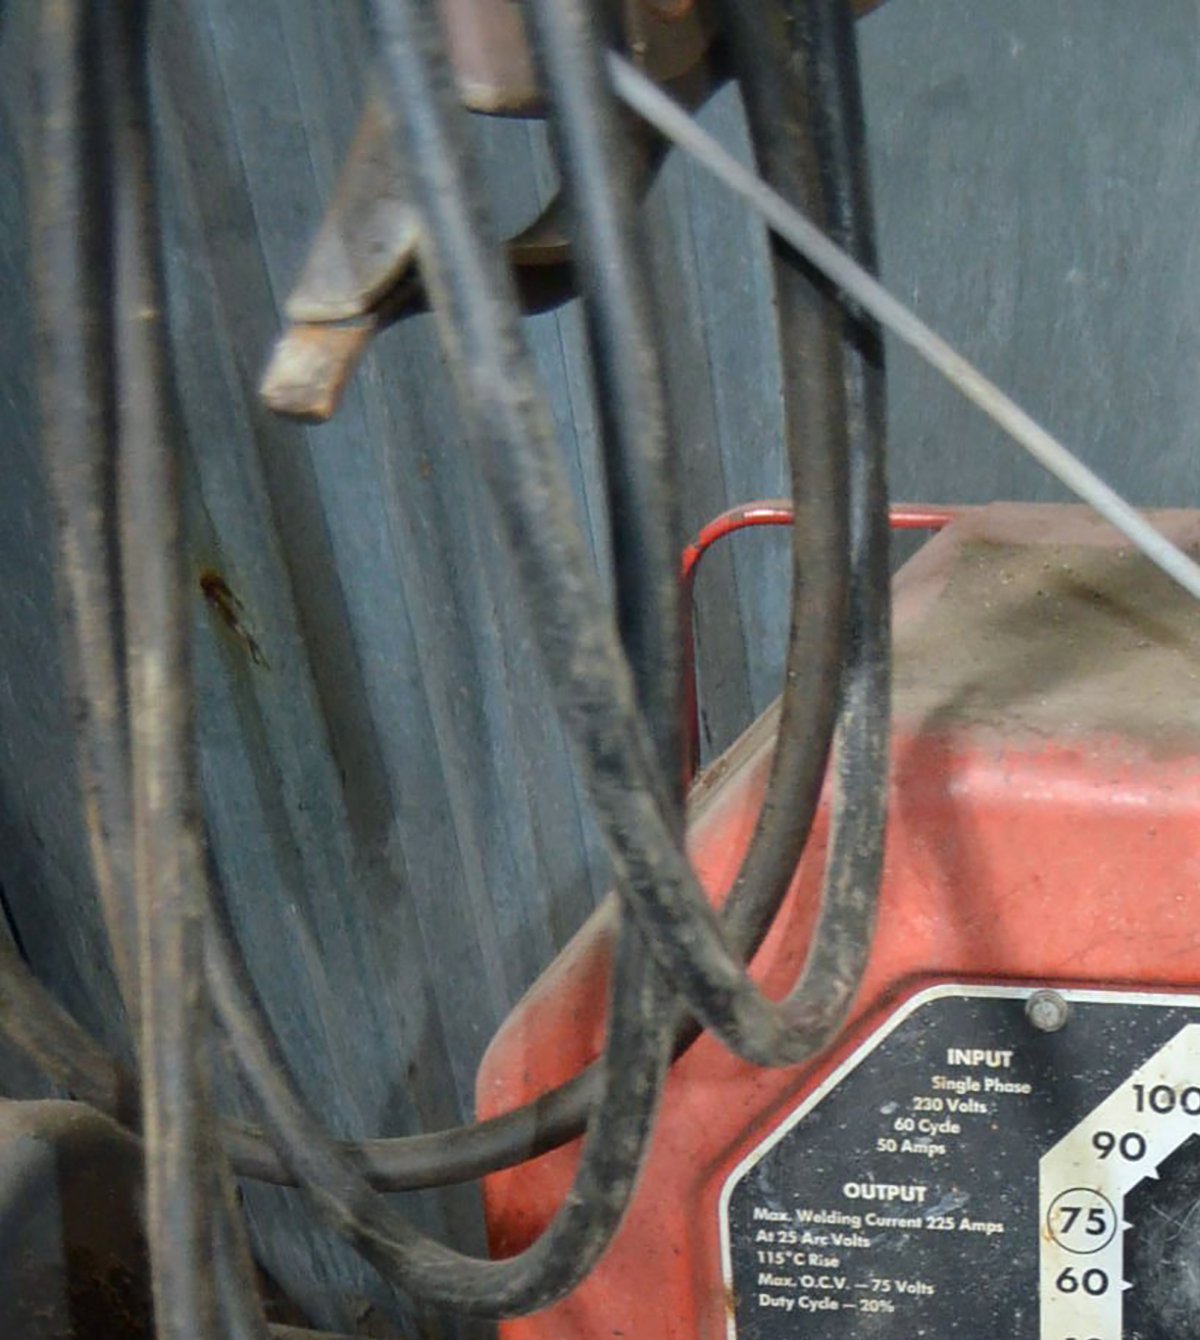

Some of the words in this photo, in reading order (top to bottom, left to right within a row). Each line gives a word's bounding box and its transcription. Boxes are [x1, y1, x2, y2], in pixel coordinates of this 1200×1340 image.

[947, 1048, 1014, 1068] INPUT
[932, 1076, 980, 1094] Single
[984, 1079, 1032, 1094] Phase
[913, 1098, 943, 1112] 230
[946, 1099, 988, 1114] Volts
[894, 1118, 914, 1131] 60
[919, 1120, 961, 1136] Cycle
[877, 1139, 897, 1152] 50
[901, 1140, 946, 1158] Amps
[1093, 1131, 1147, 1162] 90
[843, 1182, 927, 1202] OUTPUT
[753, 1208, 792, 1223] Max.
[796, 1209, 862, 1229] Welding
[865, 1213, 922, 1229] Current
[926, 1217, 955, 1230] 225
[959, 1219, 1004, 1236] Amps
[1059, 1206, 1107, 1236] 75
[756, 1229, 776, 1243] At
[778, 1230, 798, 1244] 25
[802, 1231, 828, 1246] Arc
[831, 1233, 871, 1248] Volts
[809, 1253, 840, 1268] Rise
[758, 1273, 797, 1288] Max.
[800, 1275, 850, 1290] O.C.V.
[896, 1280, 934, 1295] Volts
[1056, 1268, 1109, 1296] 60
[759, 1294, 797, 1310] Duty
[799, 1296, 839, 1312] Cycle
[859, 1299, 894, 1313] 20%
